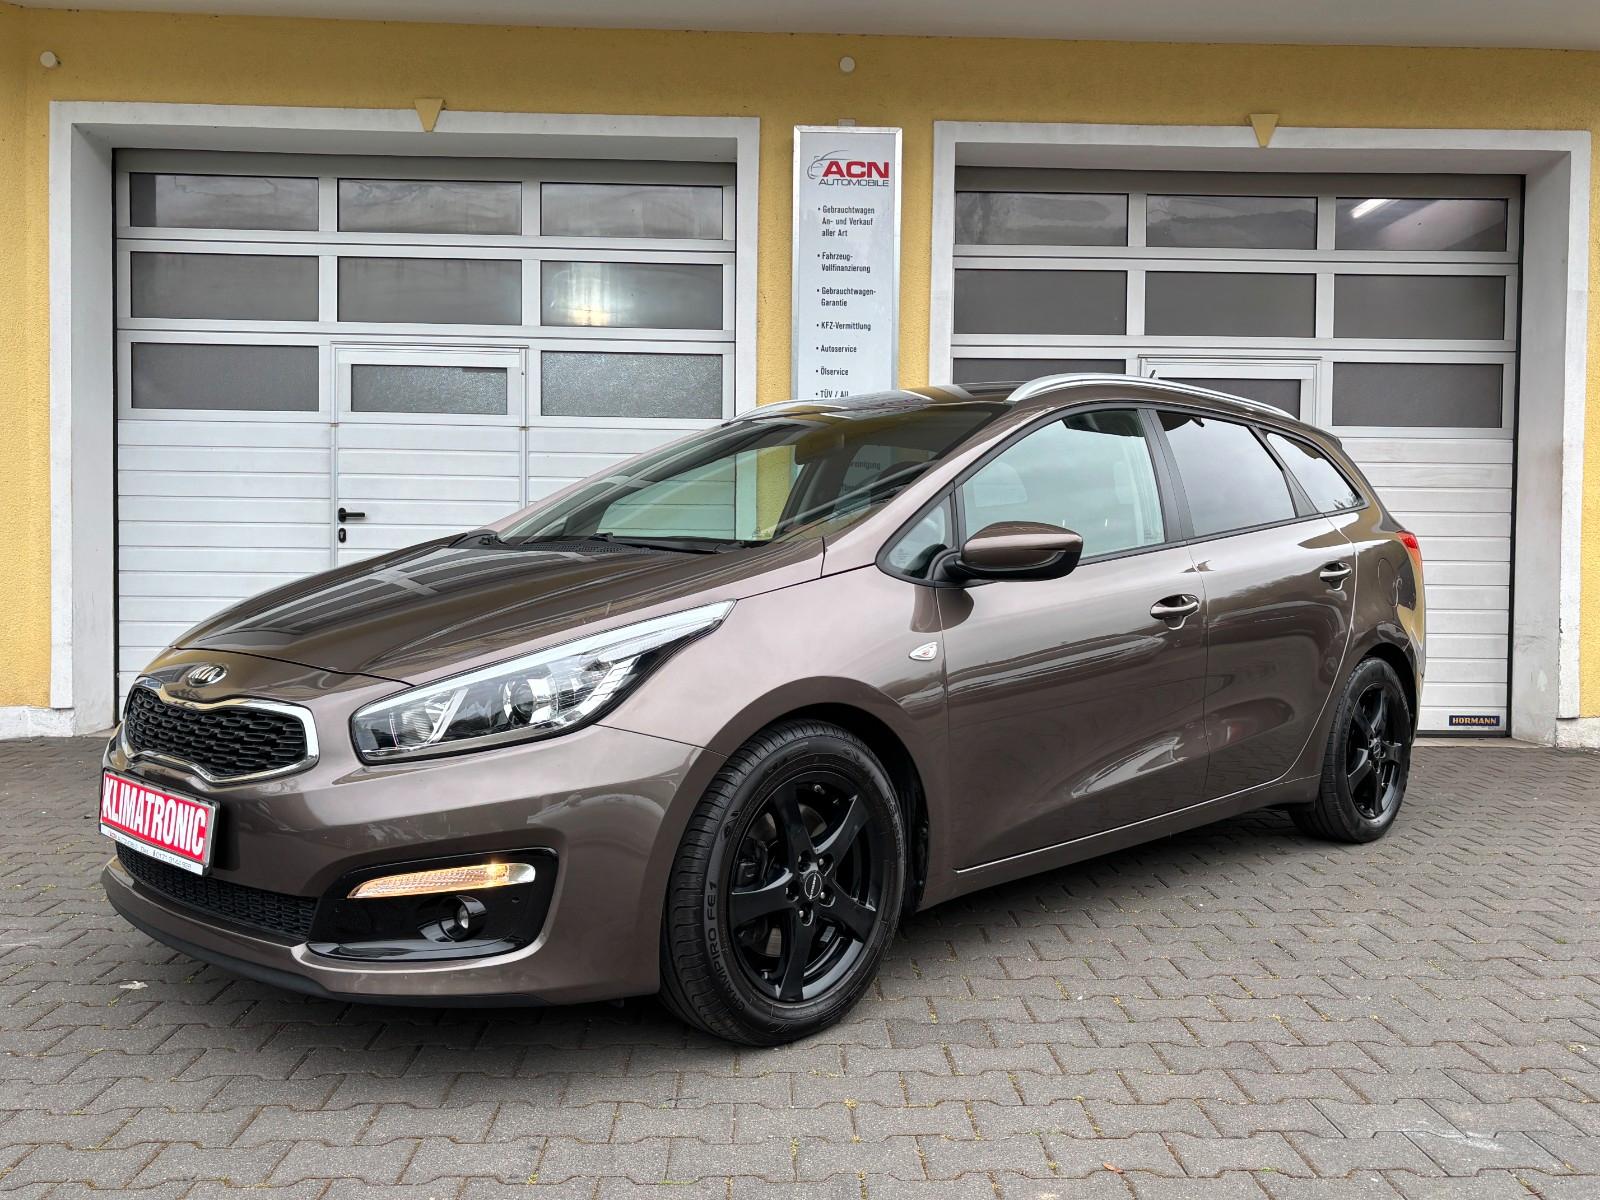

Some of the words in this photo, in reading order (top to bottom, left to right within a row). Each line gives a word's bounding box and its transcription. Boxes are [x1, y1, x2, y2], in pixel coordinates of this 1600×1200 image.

[822, 160, 890, 178] ACN
[818, 178, 889, 187] AUTOMOBILE
[822, 205, 875, 215] Gebrauchtwagen
[821, 217, 833, 225] An-
[835, 217, 847, 226] und
[849, 217, 873, 226] Verkauf
[821, 229, 836, 237] aller
[837, 229, 848, 237] Art
[821, 252, 854, 262] Fahrzeug-
[821, 264, 871, 273] Vollfinanzierung
[821, 287, 877, 297] Gebrauchtwagen-
[821, 299, 848, 307] Garantie
[820, 321, 872, 332] KFZ-Vermittlung
[820, 345, 857, 353] Autoservice
[820, 366, 849, 376] Ölservice
[820, 388, 833, 398] TÜV
[103, 777, 207, 856] KLIMATRONIC
[706, 880, 718, 921] FE1
